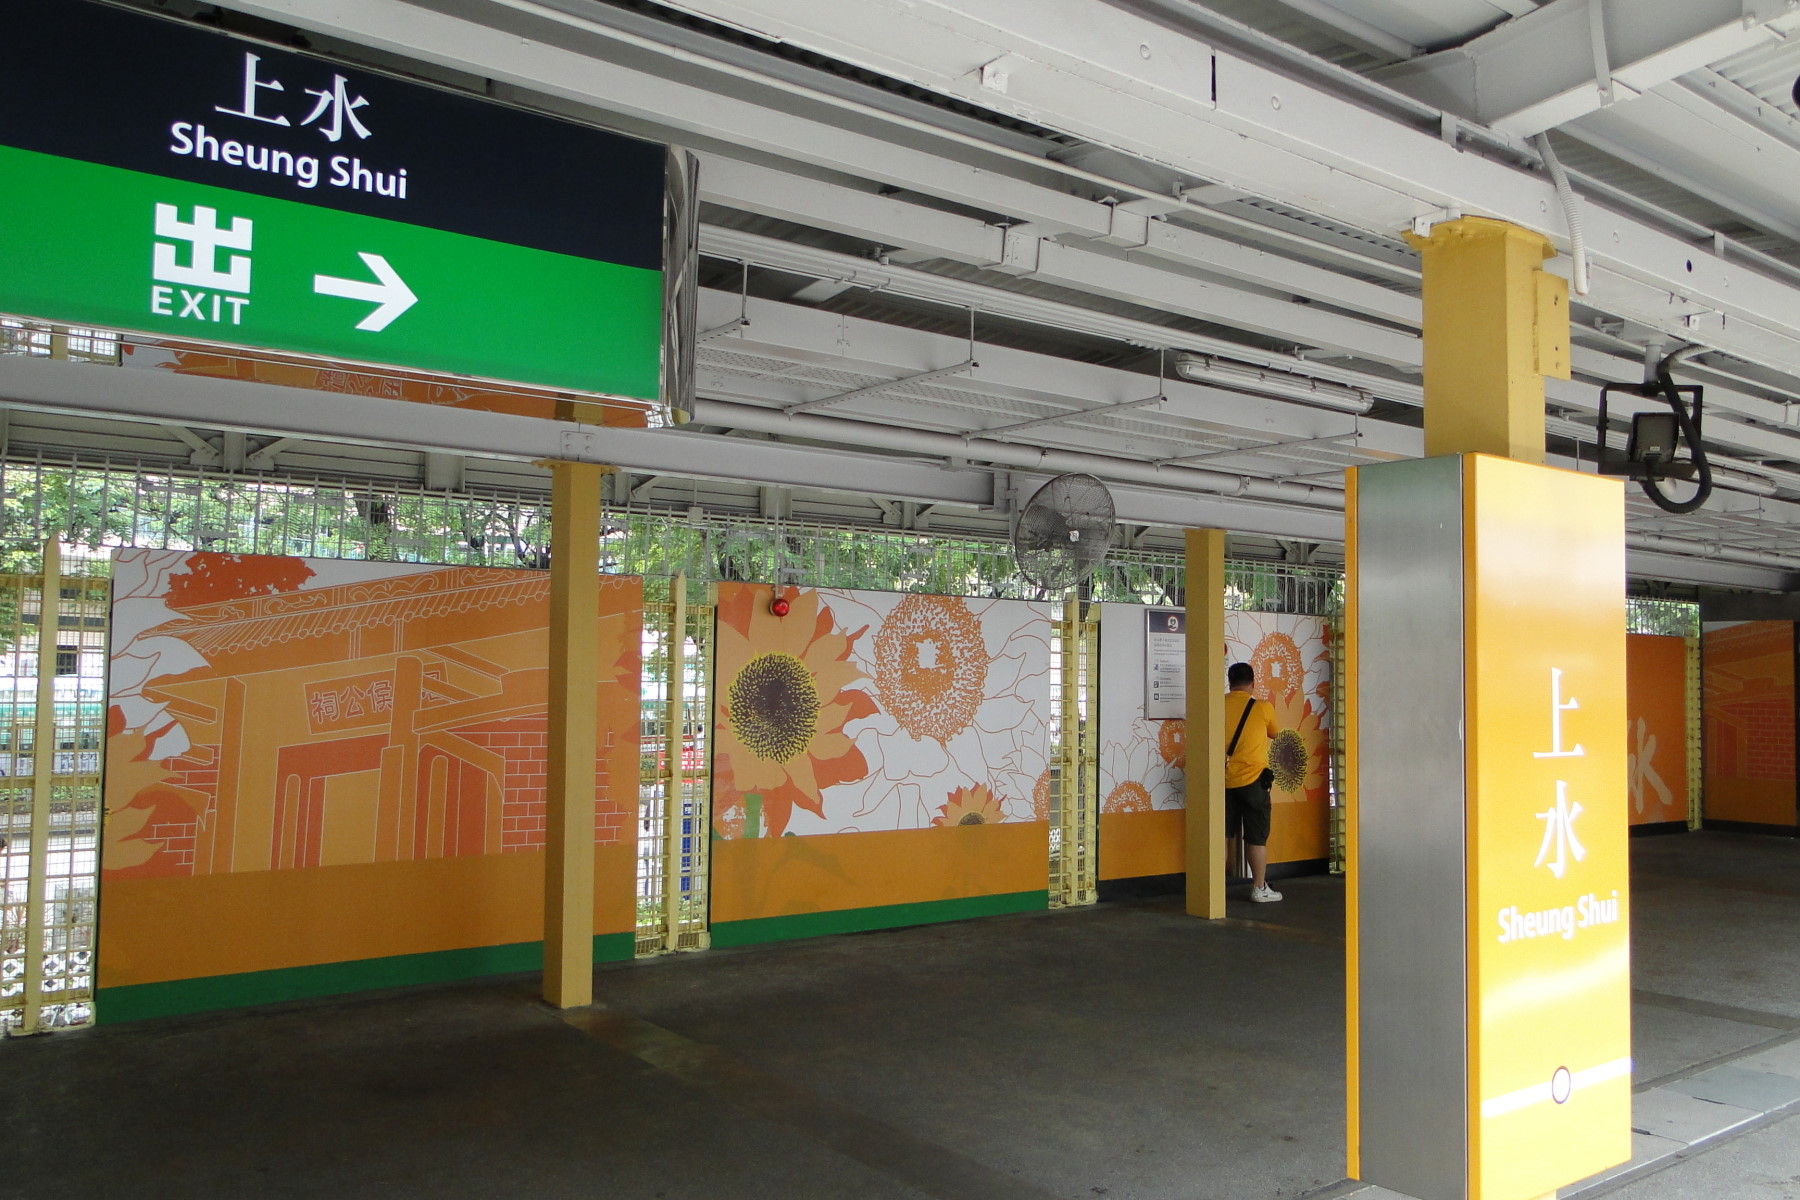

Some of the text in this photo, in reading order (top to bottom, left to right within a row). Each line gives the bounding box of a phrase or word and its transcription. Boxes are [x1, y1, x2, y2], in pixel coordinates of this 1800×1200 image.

[215, 52, 372, 142] 上水
[170, 121, 407, 199] Sheung Shui
[153, 203, 253, 294] 出
[151, 285, 250, 325] EXIT
[1532, 666, 1587, 879] 上水
[1496, 889, 1619, 944] Sheung Shui
